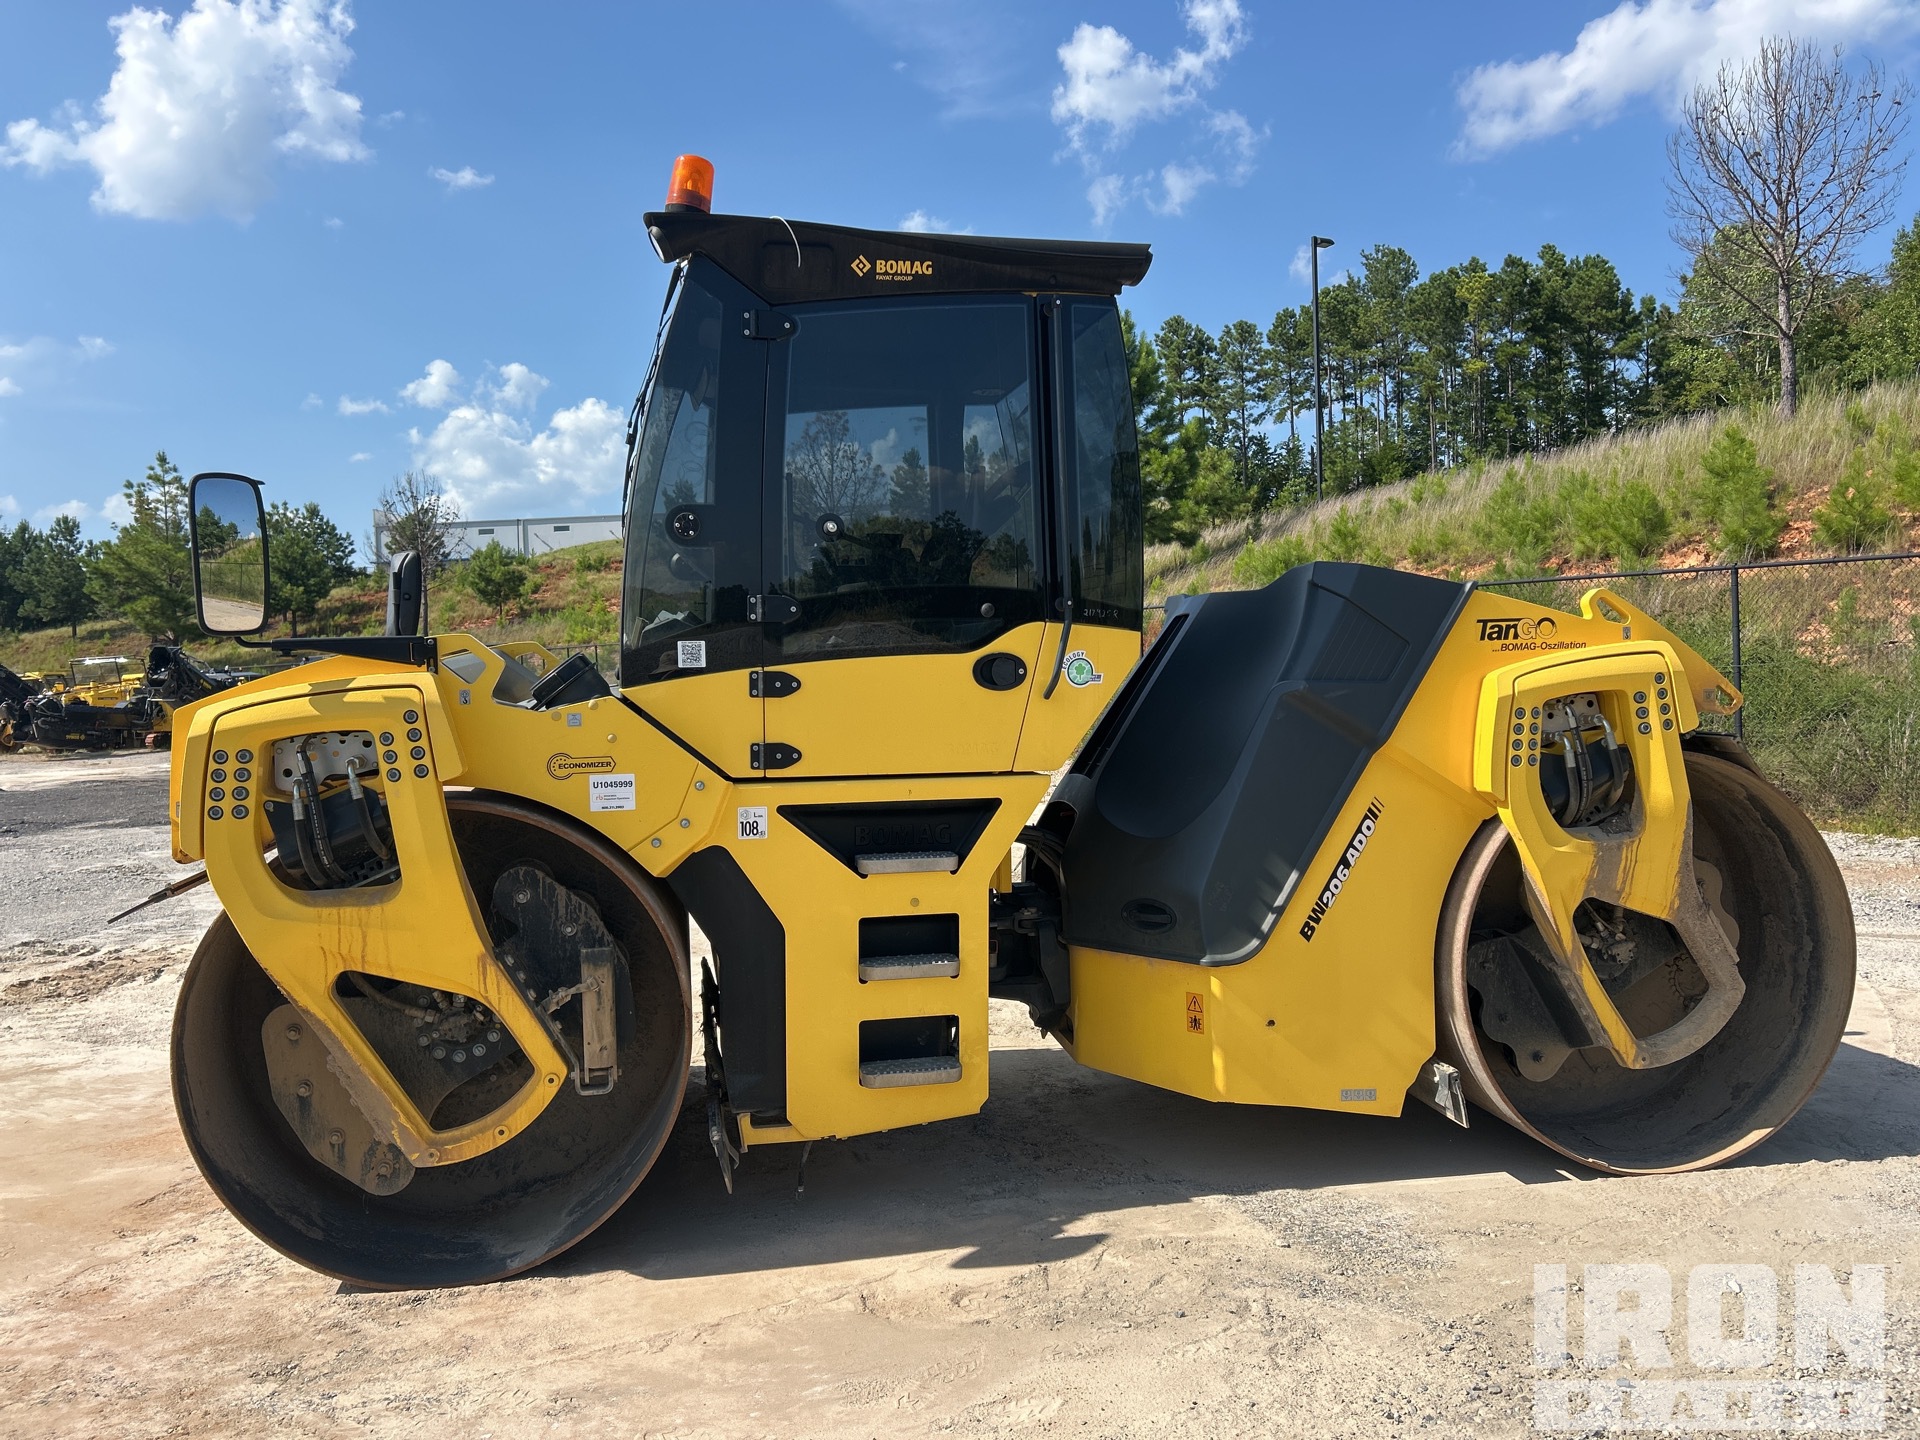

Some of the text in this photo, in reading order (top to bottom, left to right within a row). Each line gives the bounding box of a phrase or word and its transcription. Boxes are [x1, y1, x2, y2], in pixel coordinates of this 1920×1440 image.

[876, 259, 933, 275] BOMAG
[1476, 617, 1557, 642] TanGO
[1062, 651, 1085, 670] ECOLOGY
[558, 761, 612, 770] ECONOMIZER
[592, 780, 633, 789] U1045999
[740, 820, 759, 837] 108
[855, 822, 952, 846] BOMAG
[1345, 818, 1377, 869] ADO
